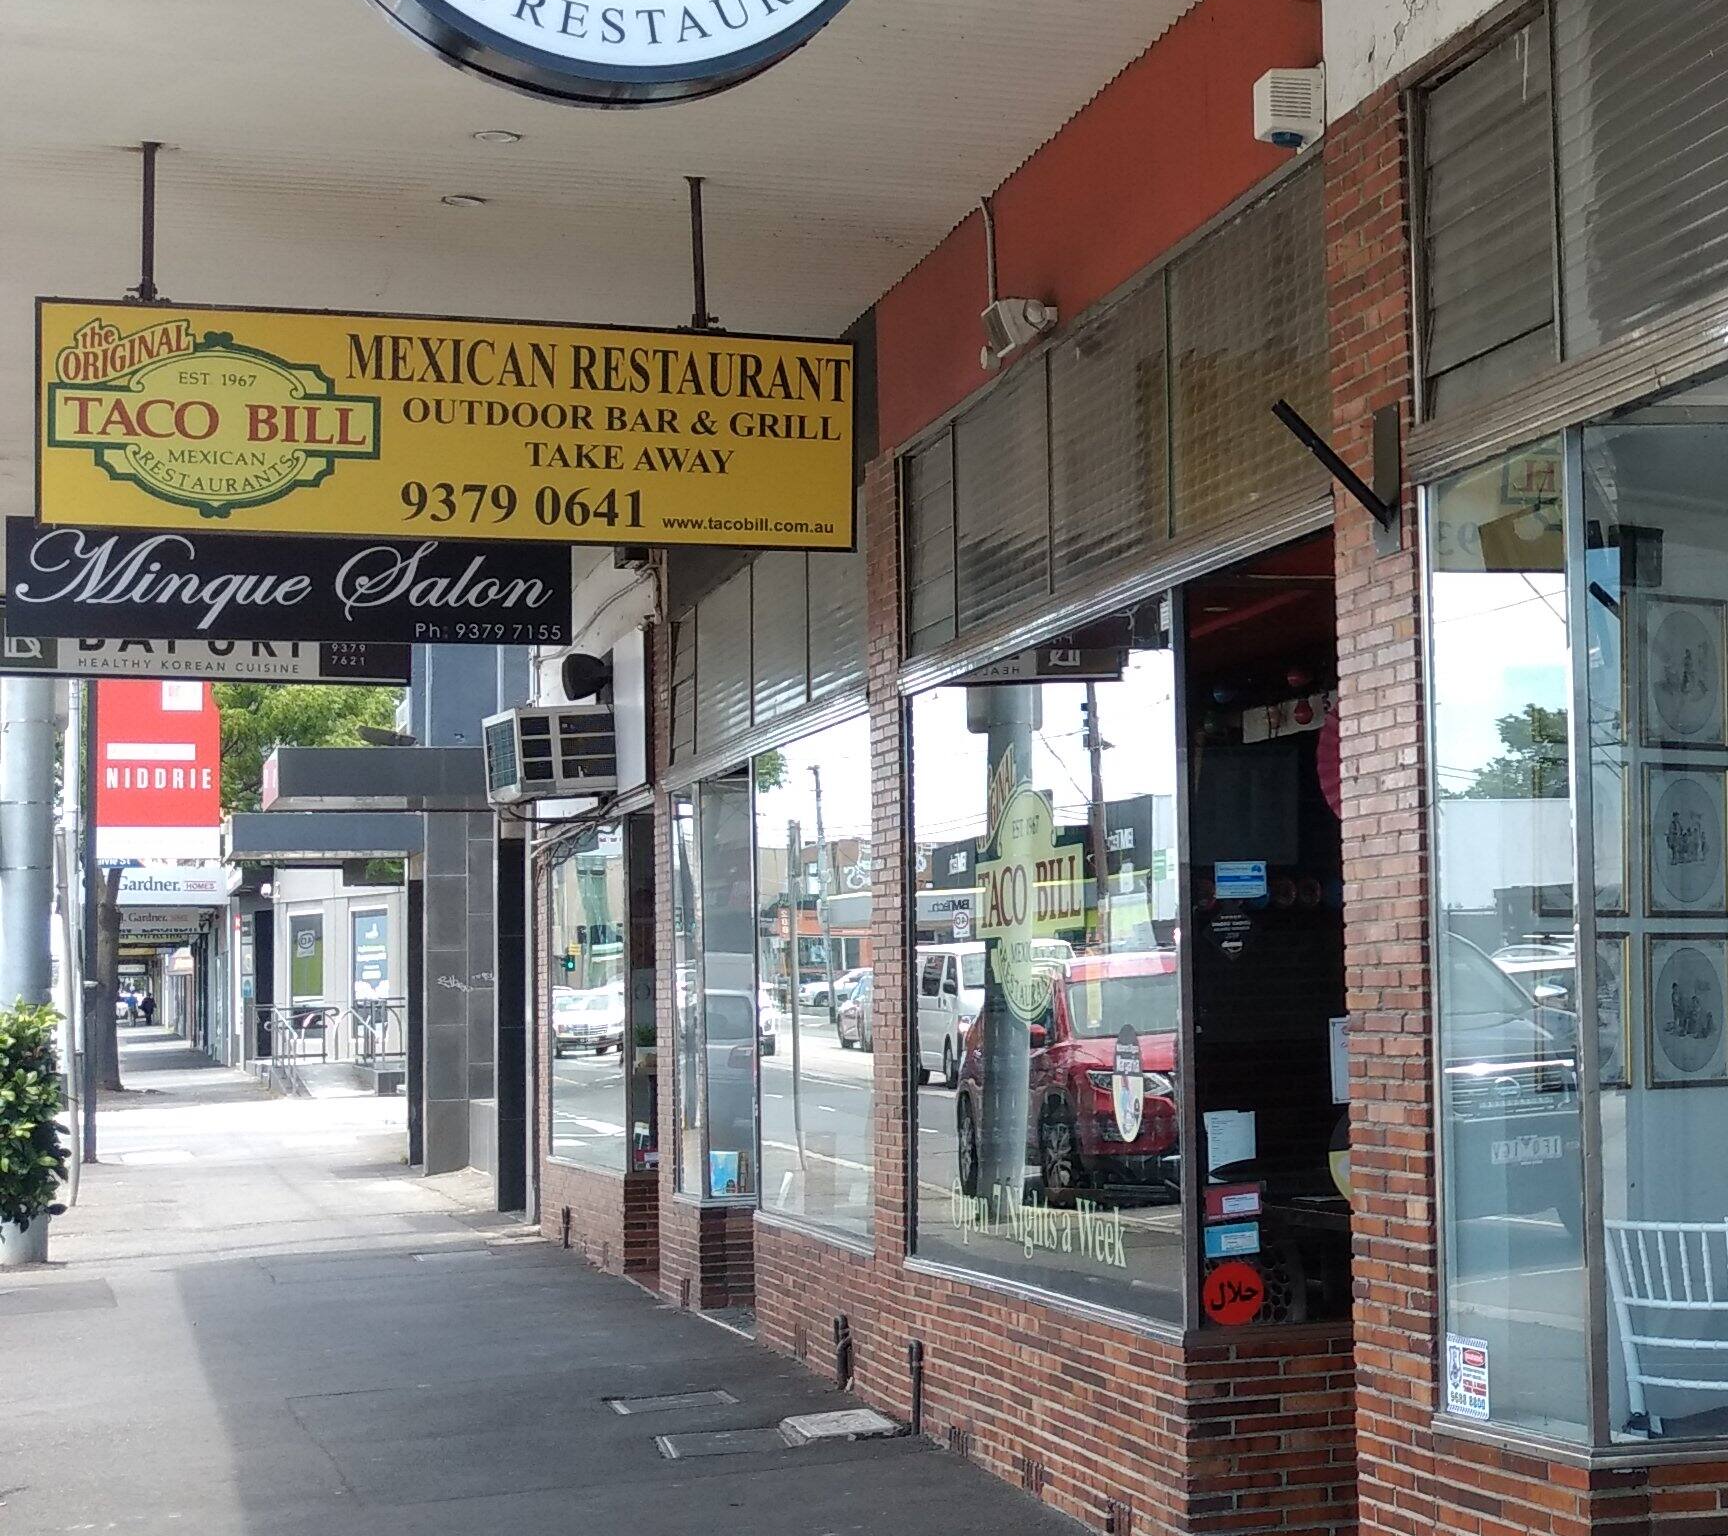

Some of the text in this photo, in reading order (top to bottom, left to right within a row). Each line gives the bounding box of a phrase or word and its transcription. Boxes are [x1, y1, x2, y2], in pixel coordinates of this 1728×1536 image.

[62, 323, 190, 382] ORIGINAL
[80, 324, 115, 350] the
[178, 371, 257, 387] EST 1967
[345, 333, 851, 404] MEXICAN RESTAURANT
[64, 396, 367, 446] TACO BILL
[402, 397, 842, 442] OUTDOOR BAR & GRILL
[140, 449, 296, 492] RESTAURANTS
[168, 449, 266, 466] MEXICAN
[525, 441, 735, 476] TAKE AWAY
[400, 481, 835, 536] 9379 0641 www.tacobill.com.au
[15, 528, 555, 631] Minque Salon
[454, 623, 504, 641] 9379
[511, 623, 562, 642] 7155
[78, 657, 300, 675] HEALTHY KOREAN CUISINE
[331, 654, 366, 667] 7621
[106, 767, 212, 789] NIDDRIE
[978, 855, 1082, 929] TACO BILL
[951, 1177, 1128, 1269] Open 7 Nights a Week
[1210, 1279, 1258, 1311] حلال
